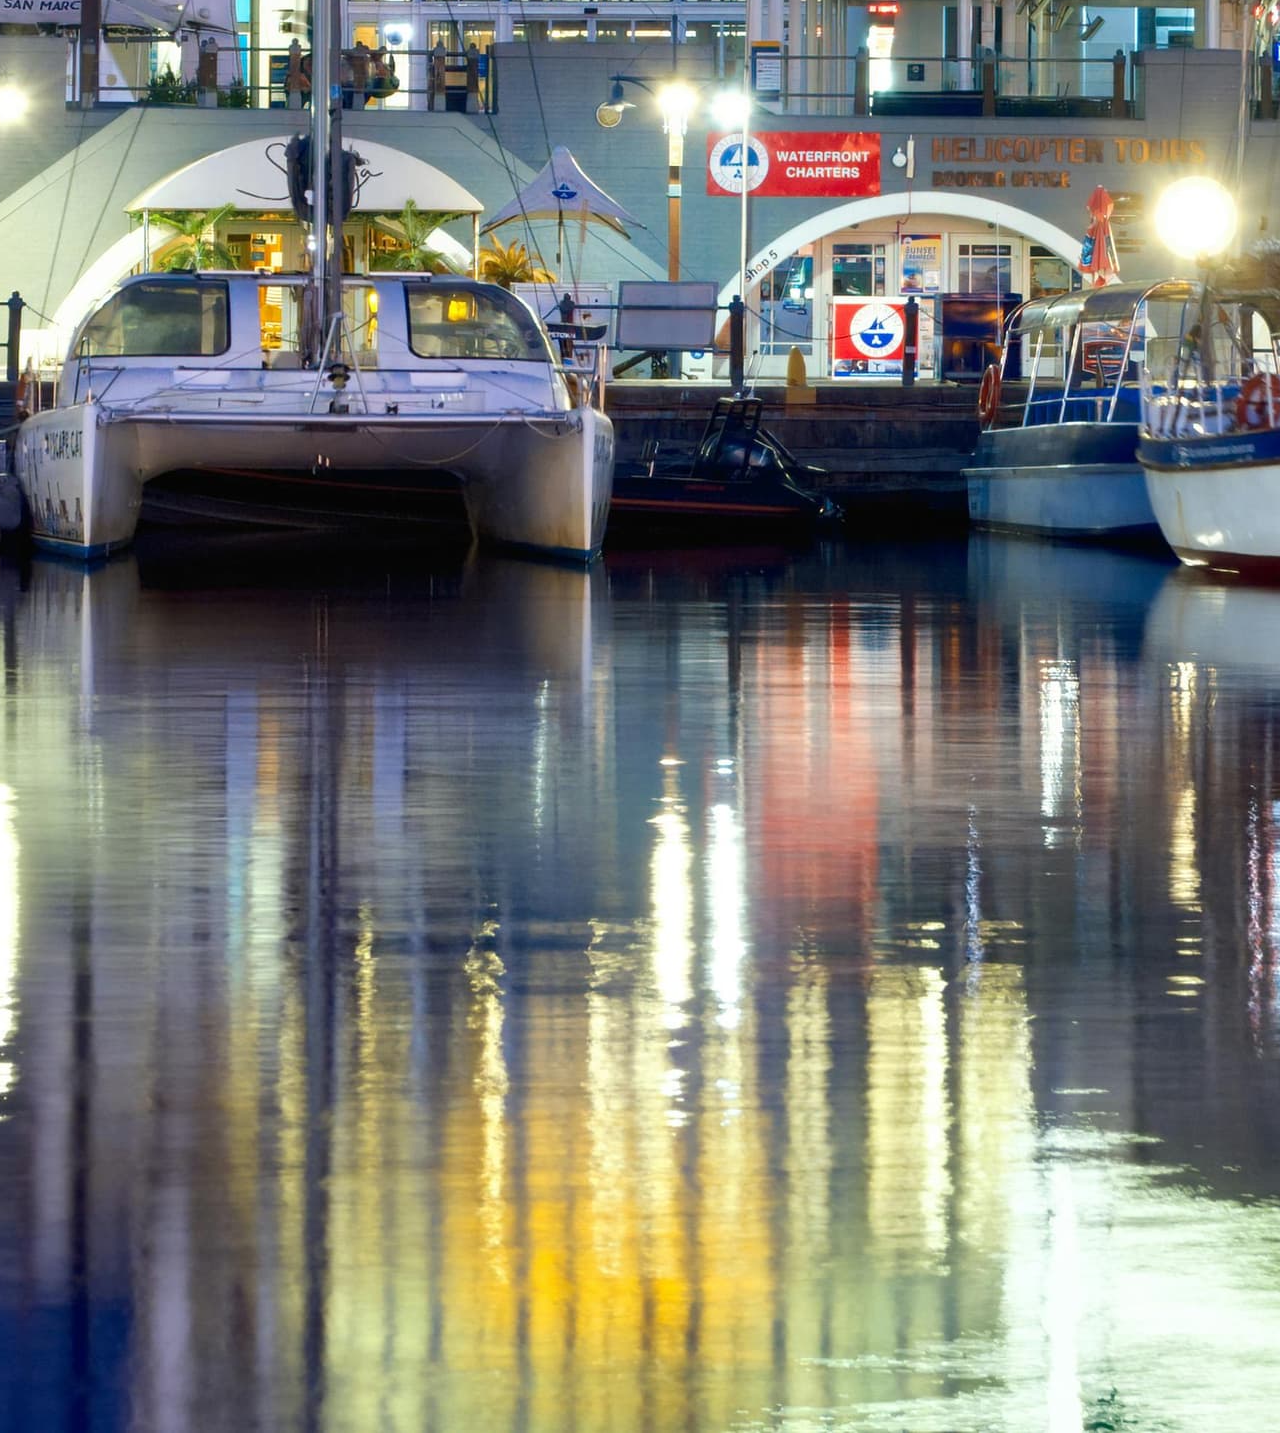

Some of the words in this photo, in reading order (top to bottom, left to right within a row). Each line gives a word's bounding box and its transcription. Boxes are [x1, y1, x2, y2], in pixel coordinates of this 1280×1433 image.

[776, 150, 870, 163] WATERFRONT
[931, 137, 1104, 164] HELICOPTER
[1114, 137, 1206, 164] TOURS
[785, 166, 860, 179] CHARTERS
[769, 250, 778, 261] 5
